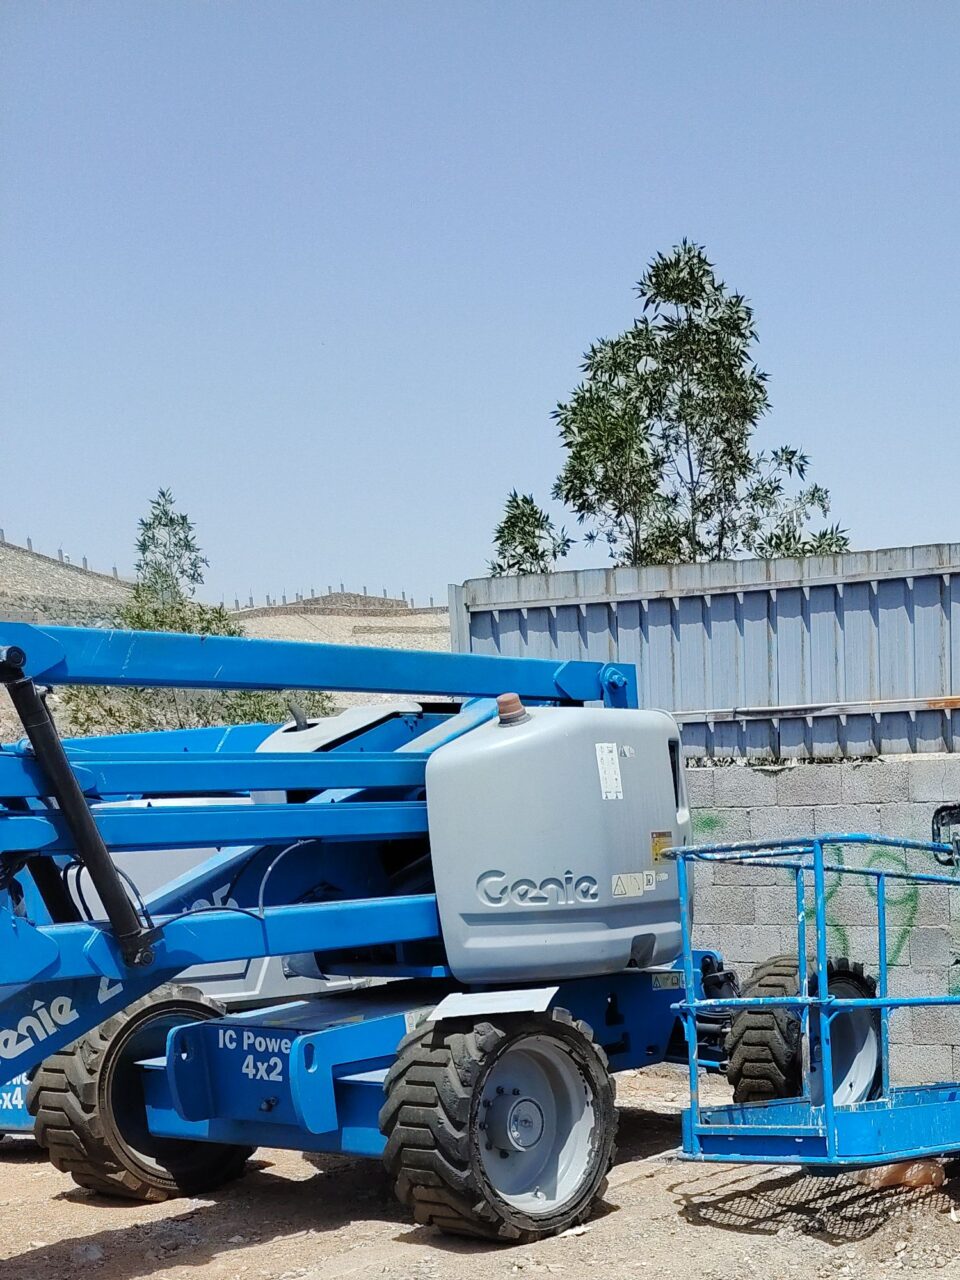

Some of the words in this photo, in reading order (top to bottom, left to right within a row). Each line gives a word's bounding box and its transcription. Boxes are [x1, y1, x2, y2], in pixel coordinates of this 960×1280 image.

[477, 870, 599, 907] Genie
[0, 996, 80, 1060] enie
[218, 1029, 237, 1050] IC
[243, 1031, 292, 1054] Powe
[241, 1054, 283, 1082] 4x2
[0, 1086, 24, 1110] x4
